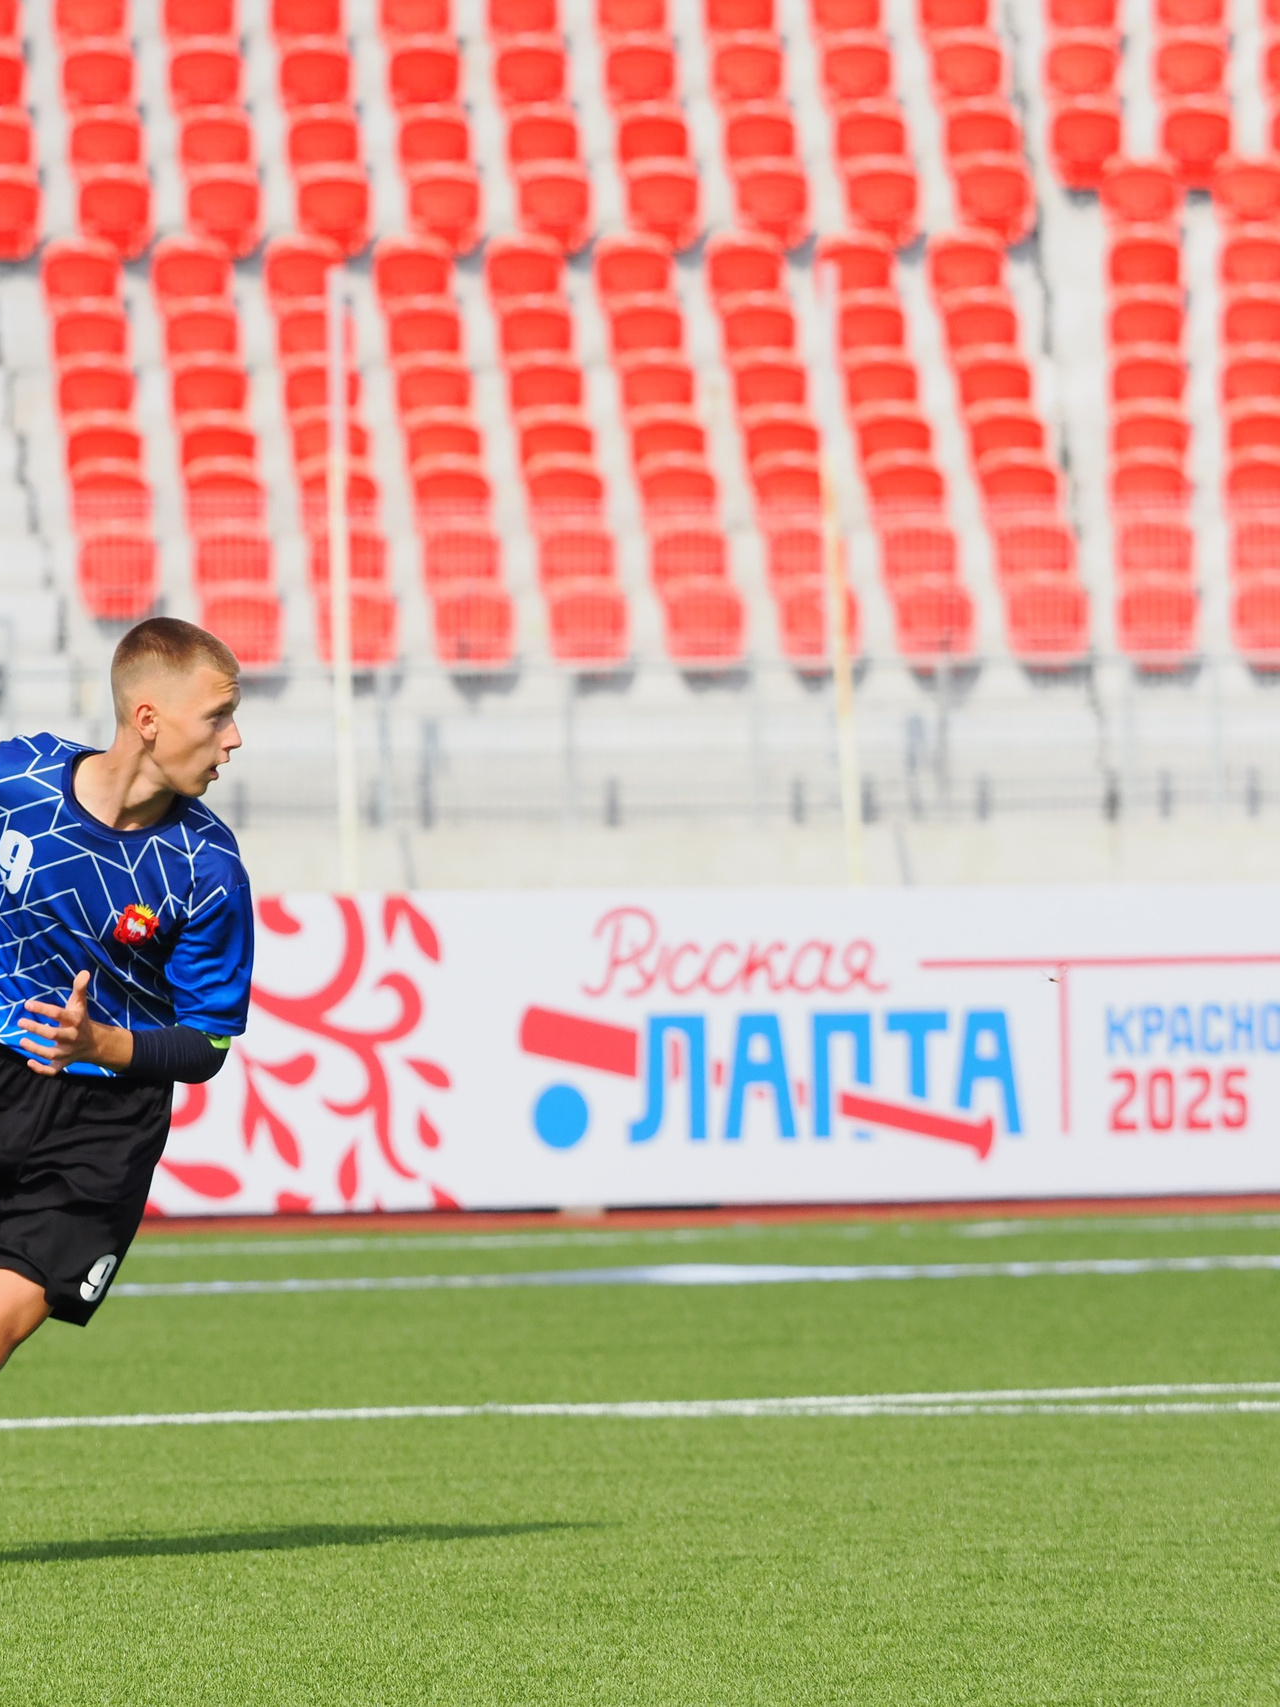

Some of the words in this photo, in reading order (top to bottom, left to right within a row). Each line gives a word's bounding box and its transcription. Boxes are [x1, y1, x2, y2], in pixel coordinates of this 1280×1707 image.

[585, 908, 886, 996] Русская
[629, 1009, 1023, 1144] ЛАПТА
[1109, 1068, 1248, 1133] 2025
[80, 1254, 118, 1302] 9
